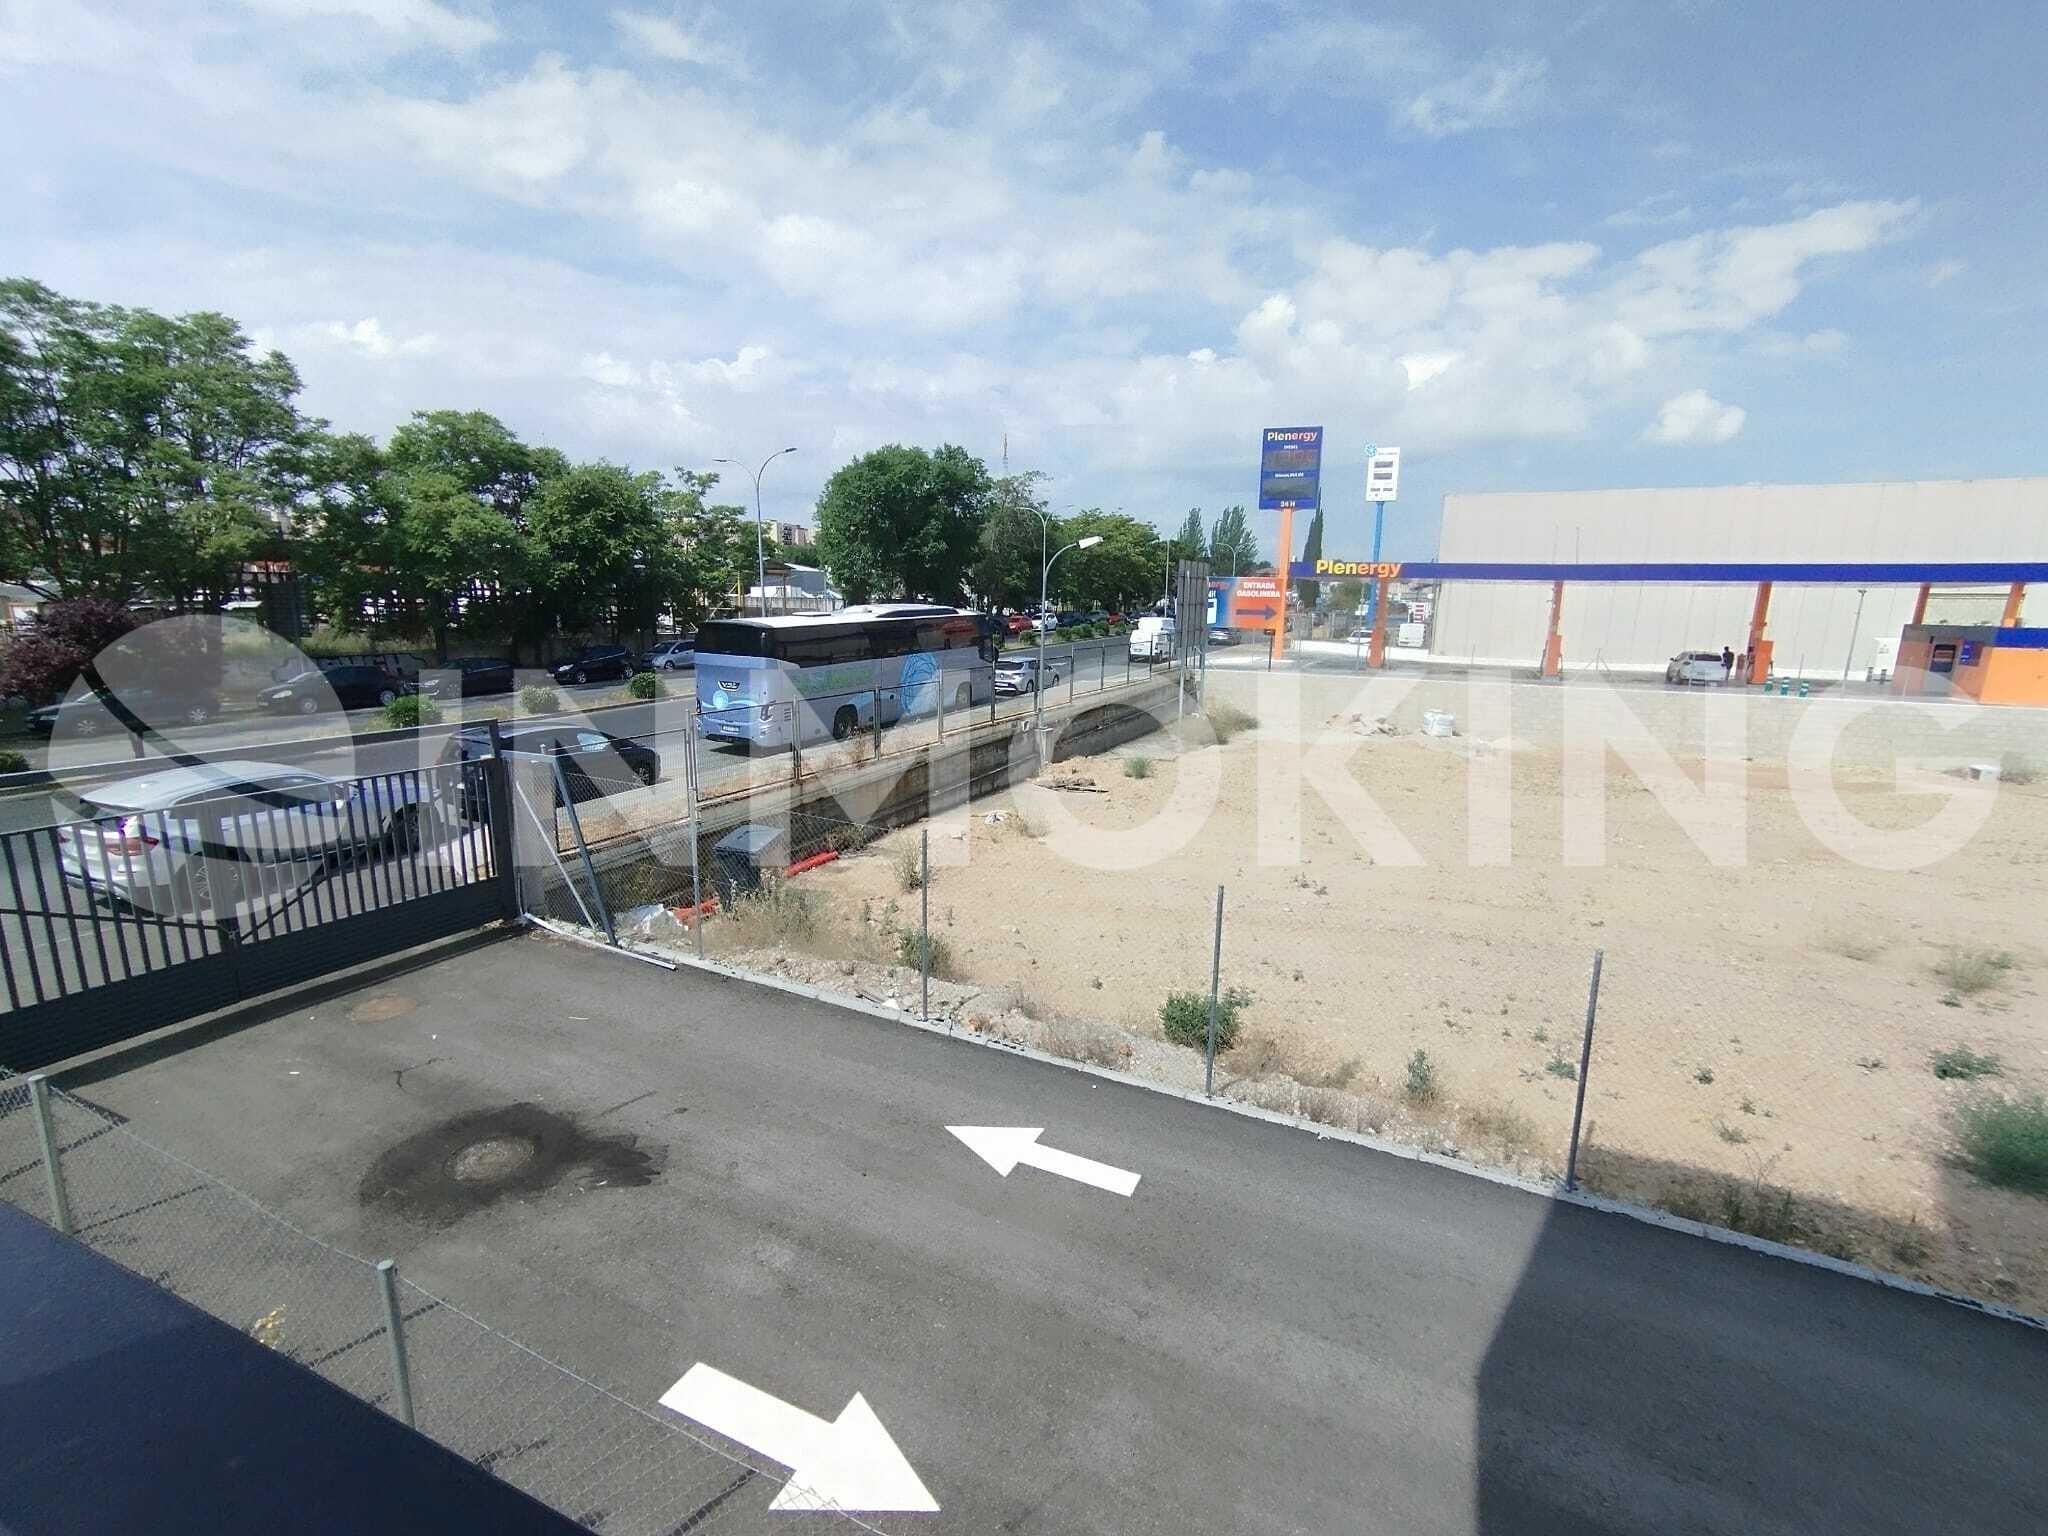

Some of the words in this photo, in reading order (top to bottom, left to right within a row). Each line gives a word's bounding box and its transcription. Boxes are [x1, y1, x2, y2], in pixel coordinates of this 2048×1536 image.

[1267, 431, 1318, 442] Plenergy
[1316, 560, 1402, 578] Plenergy
[1236, 590, 1281, 598] GASOLINERA
